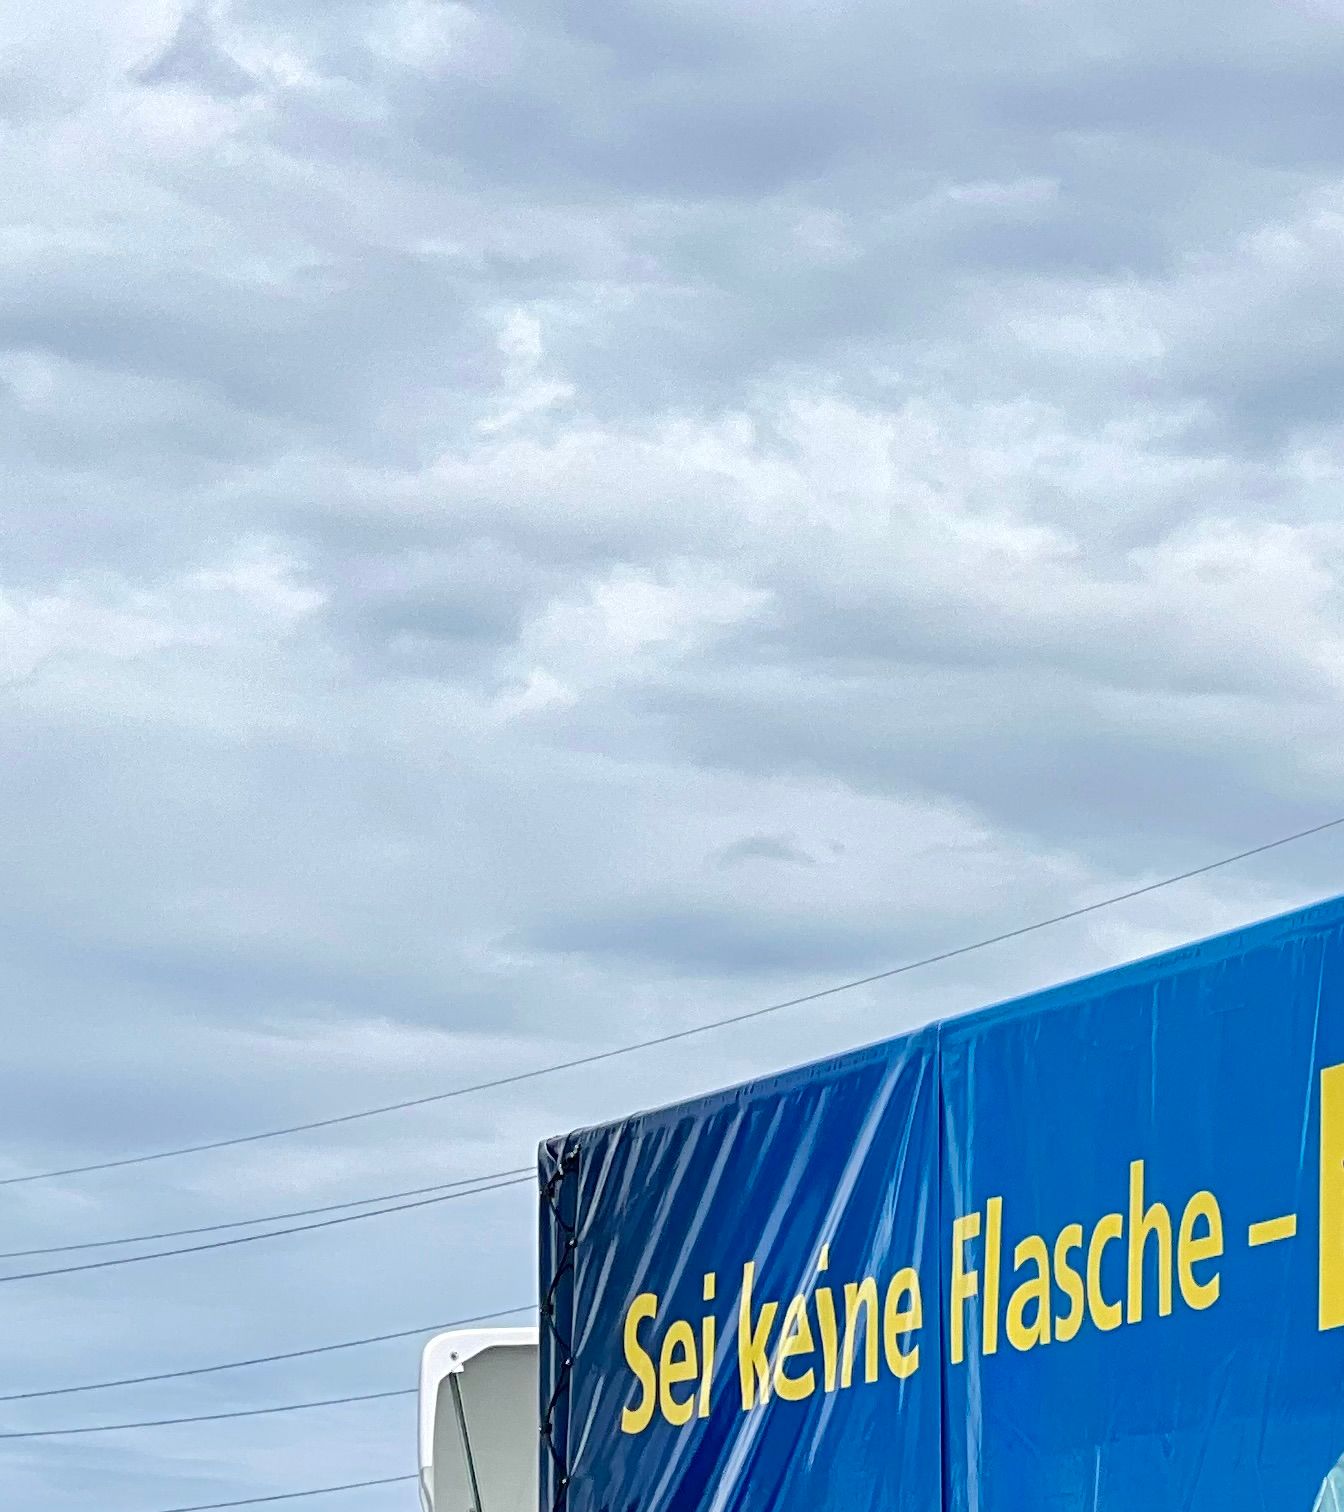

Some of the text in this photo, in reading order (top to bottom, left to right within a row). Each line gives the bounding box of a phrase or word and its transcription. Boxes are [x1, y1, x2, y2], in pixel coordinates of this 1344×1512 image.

[621, 1271, 716, 1434] Sei
[738, 1243, 922, 1411] keine
[951, 1161, 1223, 1364] Flasche
